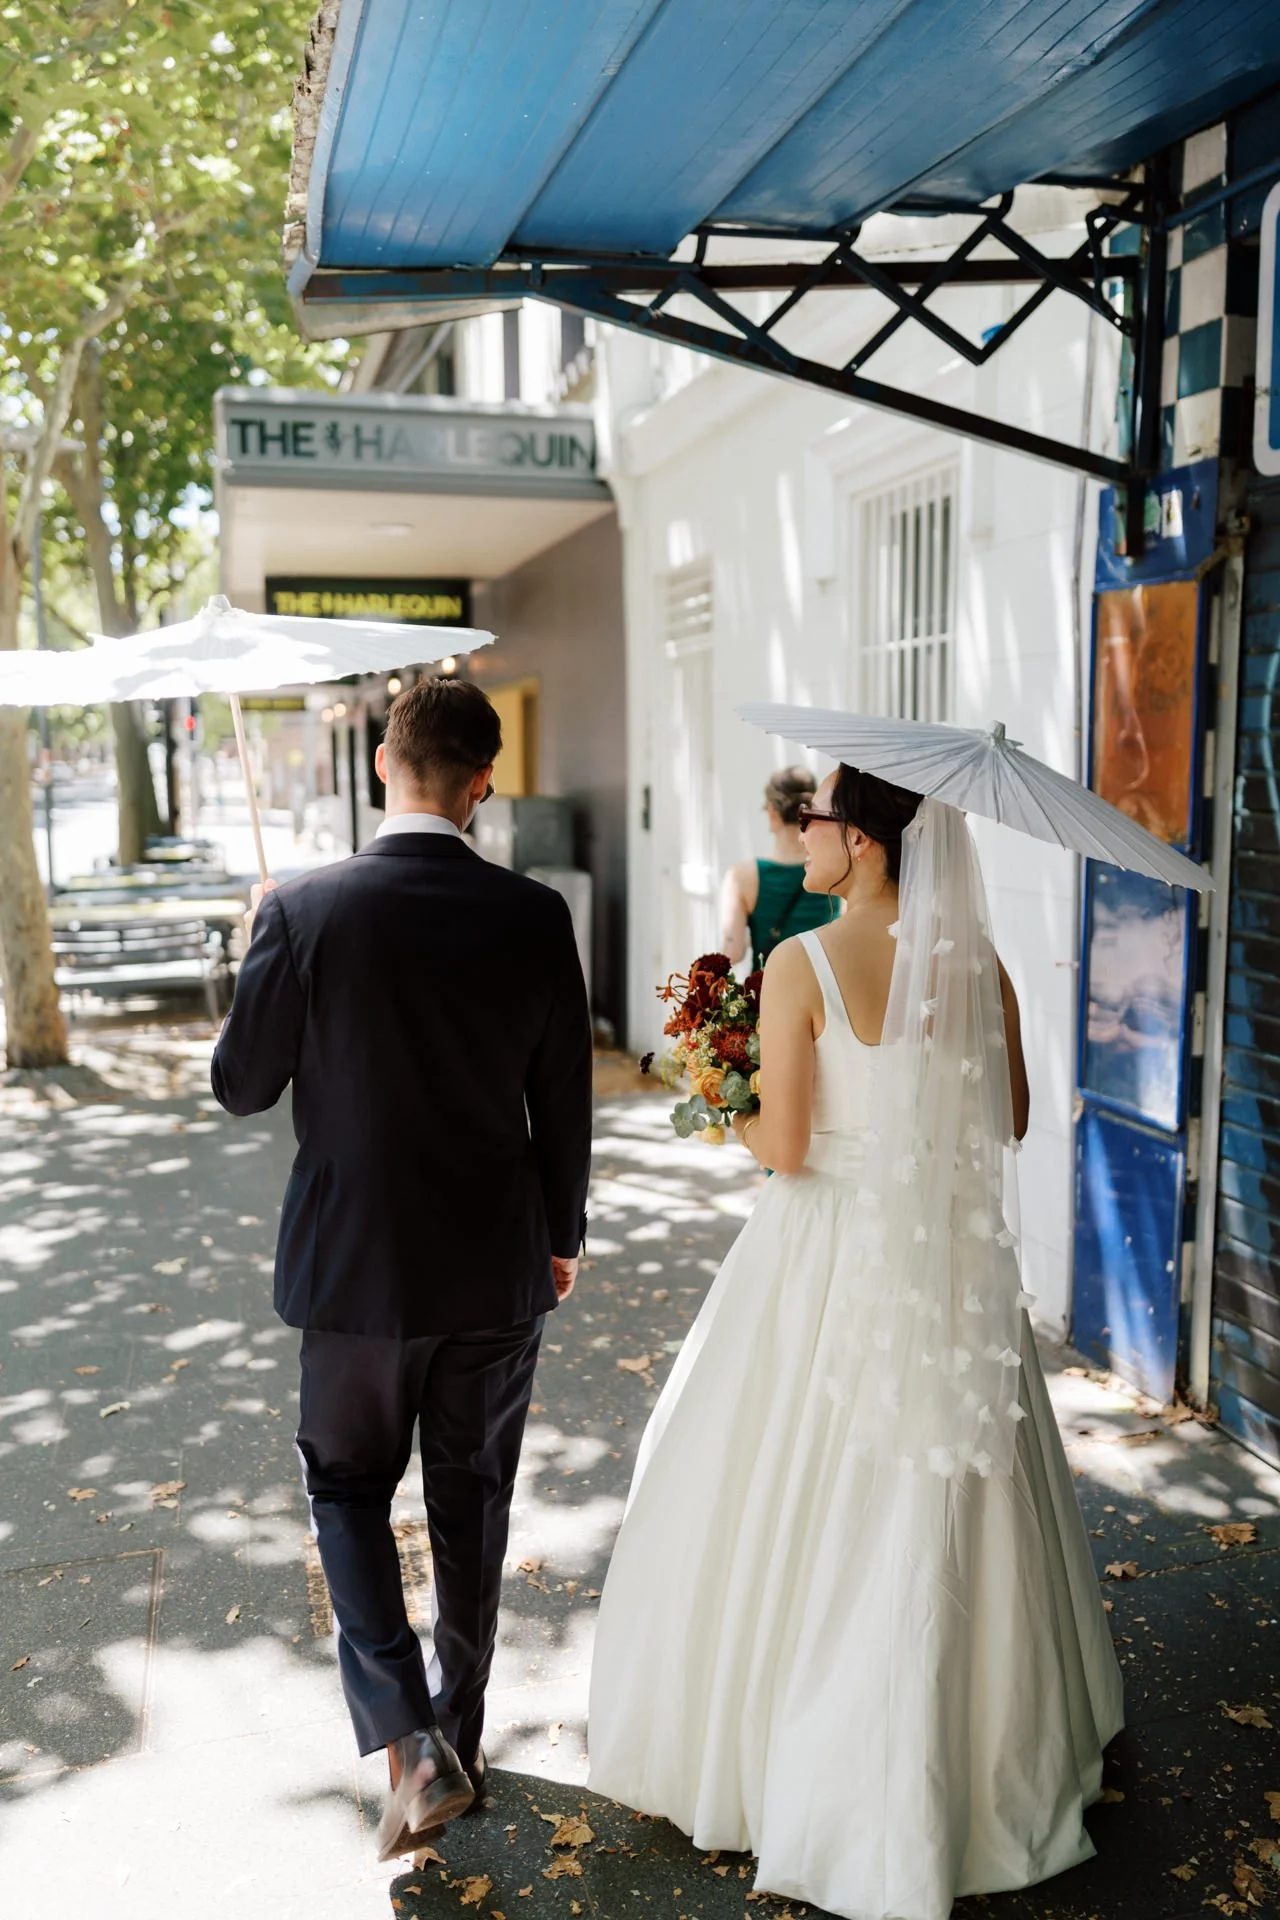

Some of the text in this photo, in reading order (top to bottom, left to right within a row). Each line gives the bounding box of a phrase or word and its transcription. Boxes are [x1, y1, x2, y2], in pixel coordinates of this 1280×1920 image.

[230, 418, 597, 468] THE HALEQUIN
[274, 591, 462, 619] THE HARLEQUIN
